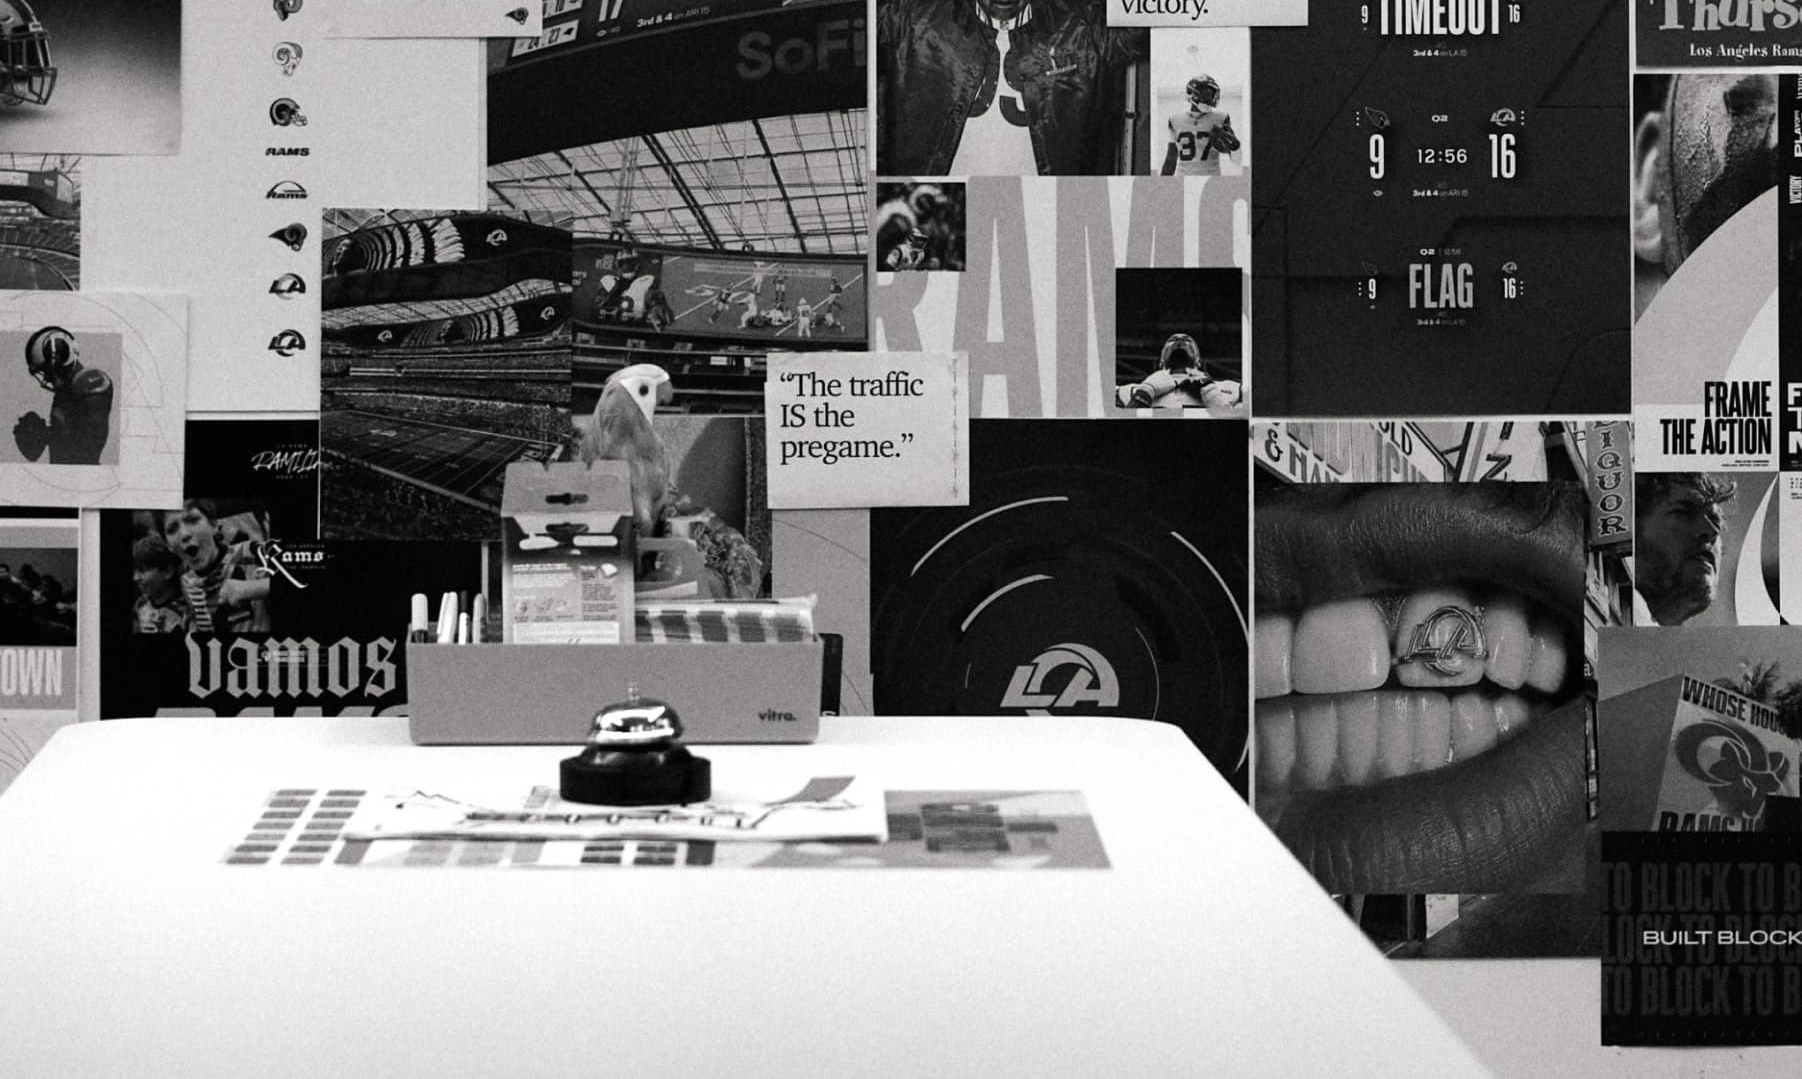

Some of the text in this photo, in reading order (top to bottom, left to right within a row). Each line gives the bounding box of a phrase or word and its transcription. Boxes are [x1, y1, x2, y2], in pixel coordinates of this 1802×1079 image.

[1361, 4, 1369, 24] 9
[1508, 4, 1520, 23] 16
[736, 18, 865, 80] SoFi
[1689, 43, 1714, 56] Los
[1716, 43, 1769, 61] Angeles
[265, 147, 310, 157] RAMS
[1176, 131, 1213, 162] 37
[1369, 133, 1385, 179] 9
[1417, 148, 1468, 164] 12:56
[1488, 133, 1516, 179] 16
[1368, 278, 1376, 300] 9
[1409, 263, 1474, 309] FLAG
[1503, 277, 1517, 299] 16
[779, 370, 925, 397] “The traffic
[1704, 380, 1772, 418] FRAME
[779, 403, 855, 428] IS the
[779, 434, 915, 466] pregame.”
[1660, 418, 1697, 455] THE
[1701, 418, 1772, 455] ACTION
[255, 539, 325, 588] Rams
[1000, 642, 1120, 716] LA
[1683, 676, 1786, 734] WHOSE HOU
[1641, 861, 1732, 912] BLOCK
[1738, 861, 1775, 912] TO
[1642, 930, 1802, 946] BUILT BLOCK
[1641, 964, 1732, 1015] BLOCK
[1738, 964, 1775, 1015] TO
